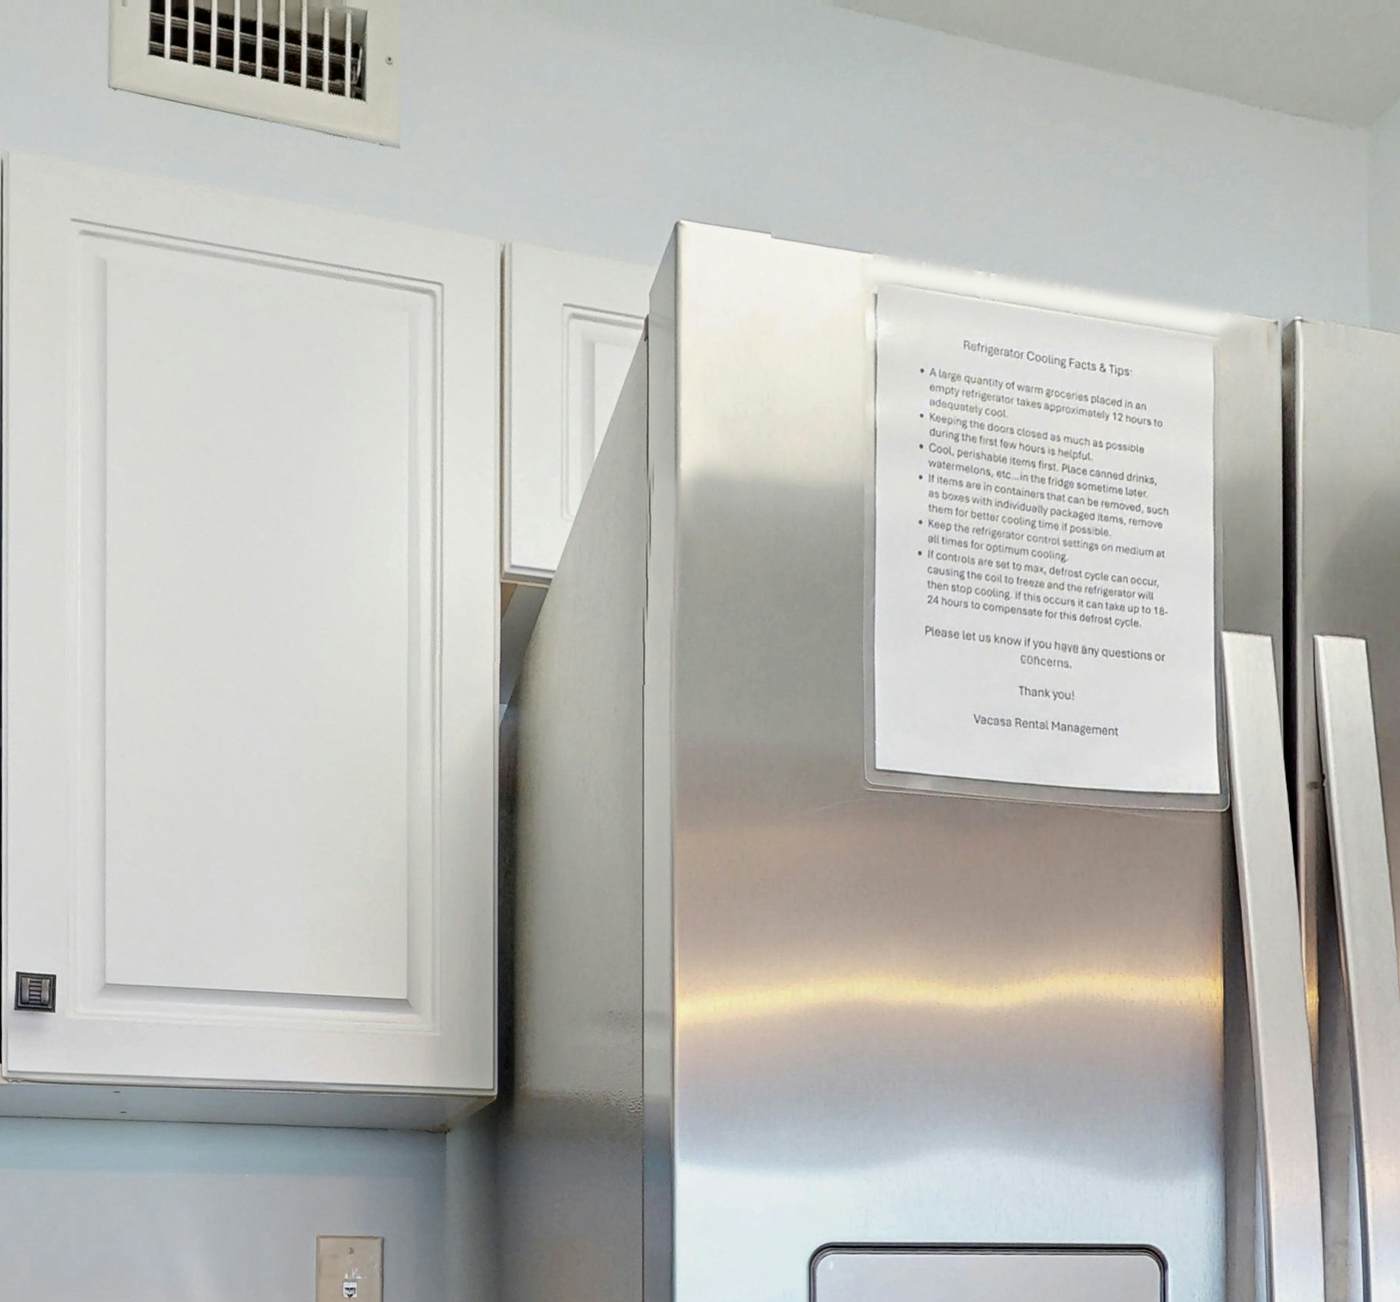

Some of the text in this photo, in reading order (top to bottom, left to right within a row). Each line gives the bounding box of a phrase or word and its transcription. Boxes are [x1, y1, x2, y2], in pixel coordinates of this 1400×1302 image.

[963, 340, 1024, 360] Refrigerator
[1026, 351, 1067, 368] Cooling
[1068, 357, 1097, 371] Facts
[1099, 362, 1107, 372] &
[929, 368, 1147, 411] A large quantity of warm groceries placed in an
[929, 384, 1163, 428] empty refrigerator takes approximately 12 hours to
[929, 398, 1008, 418] adequately cool.
[929, 412, 1145, 454] Keeping the doors closed as much as possible
[929, 428, 1093, 461] during the first few hours is helpful.
[928, 460, 994, 479] watermelons,
[1030, 474, 1046, 485] the
[1047, 476, 1075, 490] fridge
[1076, 481, 1123, 495] sometime
[956, 449, 1008, 464] perishable
[1009, 456, 1036, 469] items
[1061, 463, 1088, 476] Place
[1089, 469, 1125, 481] canned
[1126, 472, 1157, 486] drinks,
[928, 473, 1169, 516] If items are in containers that can be removed, such
[928, 490, 1163, 529] as boxes with individually packaged items, remove
[928, 504, 1112, 537] them for better cooling time if possible.
[928, 519, 1165, 558] Keep the refrigerator control settings on medium at
[928, 534, 940, 544] all
[941, 536, 968, 548] times
[970, 539, 984, 550] for
[985, 543, 1029, 556] optimum
[927, 549, 1159, 588] If controls are set to max, defrost cycle can occur,
[927, 566, 1154, 601] causing the coil to freeze and the refrigerator will
[927, 580, 949, 591] then
[951, 584, 973, 596] stop
[1014, 590, 1022, 600] If
[1023, 592, 1041, 603] this
[1043, 596, 1076, 606] occurs
[1078, 598, 1084, 607] it
[1085, 600, 1104, 609] can
[1105, 601, 1126, 611] take
[1127, 605, 1140, 615] up
[1141, 605, 1152, 614] to
[1154, 606, 1168, 615] 18-
[927, 594, 1142, 628] 24 hours to compensate for this defrost cycle.
[925, 626, 1166, 662] Please let us know if you have any questions or
[1019, 685, 1075, 701] Thank you!
[973, 713, 1119, 737] Vacasa Rental Management
